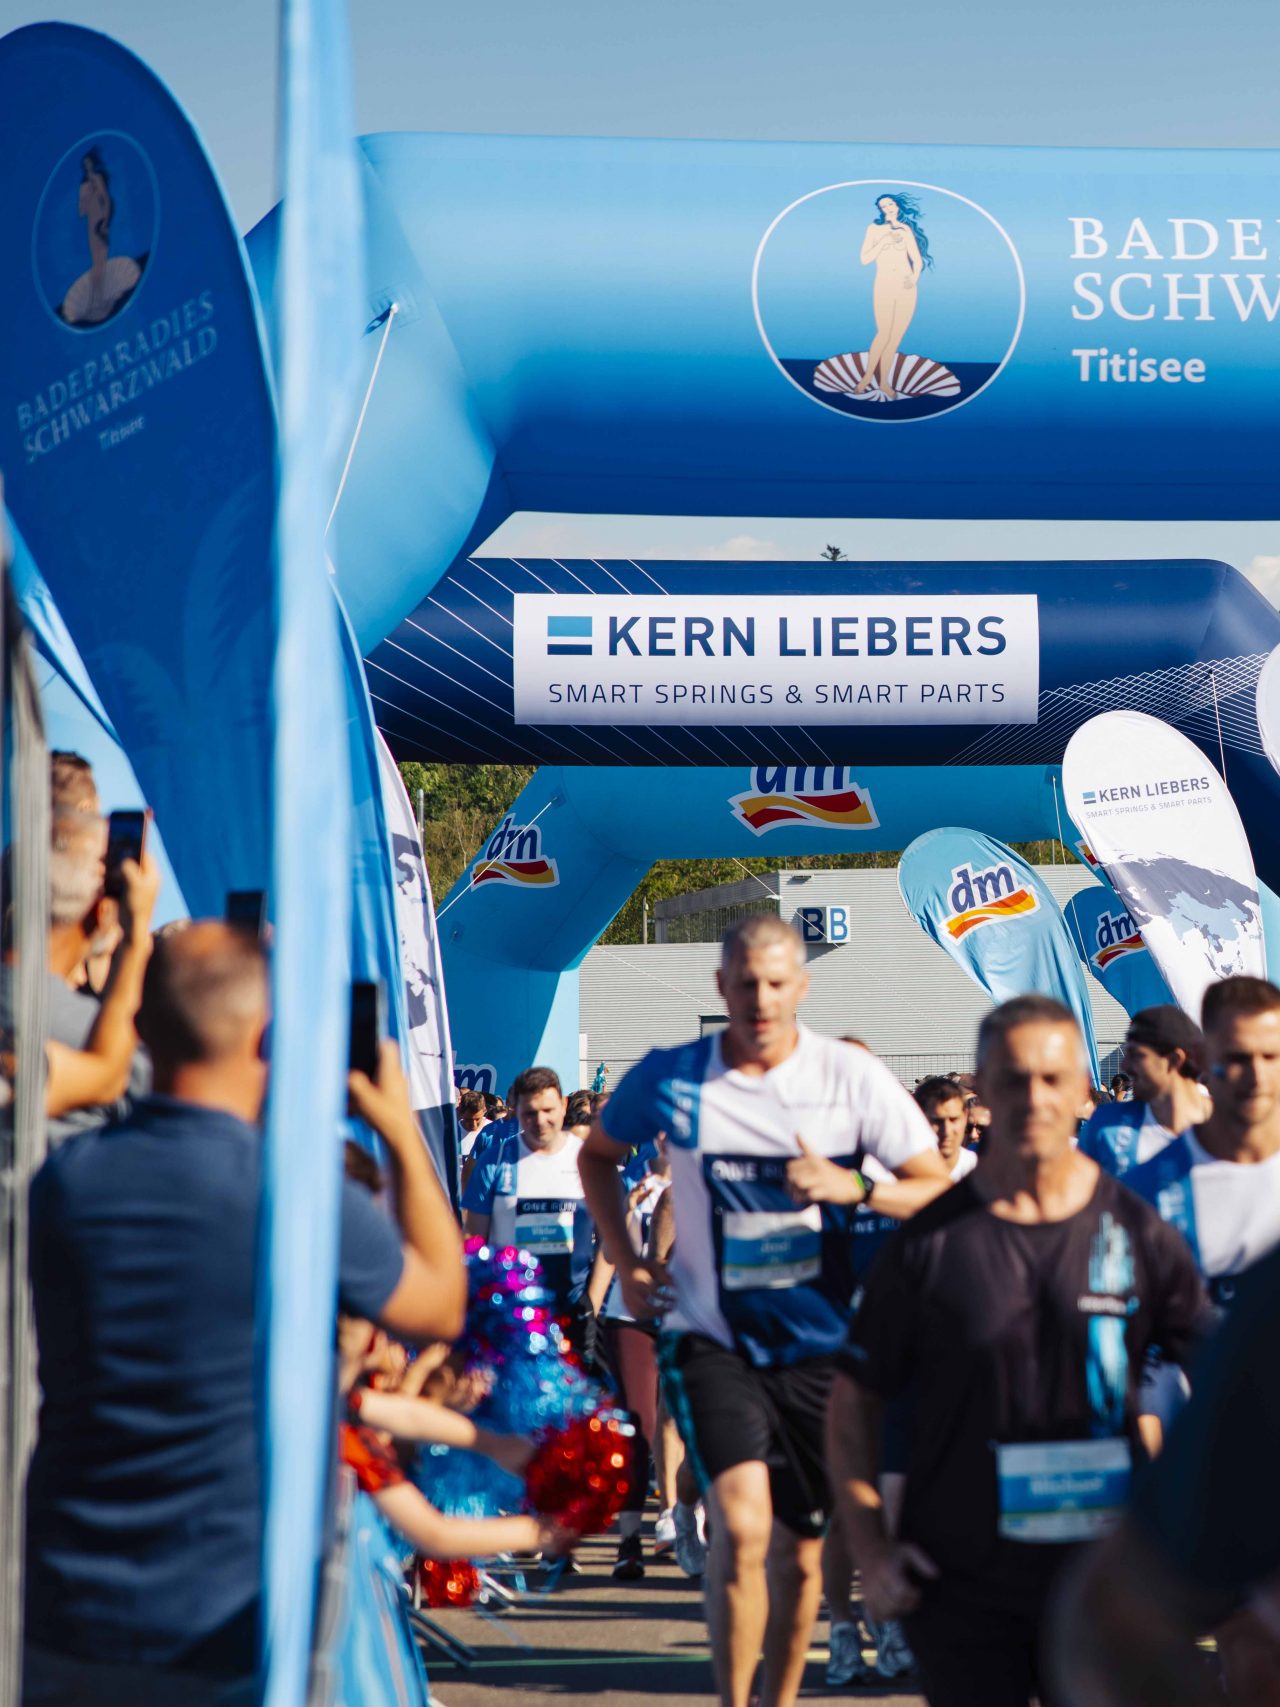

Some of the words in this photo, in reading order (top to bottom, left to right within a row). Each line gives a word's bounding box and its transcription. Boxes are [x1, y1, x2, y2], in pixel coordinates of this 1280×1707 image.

[17, 288, 215, 432] BADEPARADIES
[1071, 347, 1207, 384] Titisee
[24, 326, 219, 464] SCHWARZWALD
[608, 615, 756, 657] KERN
[778, 614, 1008, 657] LIEBERS
[547, 682, 644, 705] SMART
[655, 682, 774, 705] SPRINGS
[785, 683, 804, 704] &
[814, 682, 909, 705] SMART
[919, 682, 1006, 704] PARTS
[1085, 808, 1112, 819] SMART
[1114, 803, 1149, 815] SPRINGS
[1158, 799, 1184, 810] SMART
[1187, 795, 1213, 806] PARTS
[1098, 785, 1141, 802] KERN
[1145, 777, 1210, 797] LIEBERS
[486, 817, 538, 861] dm
[950, 865, 1016, 914] dm
[1098, 913, 1138, 949] dm
